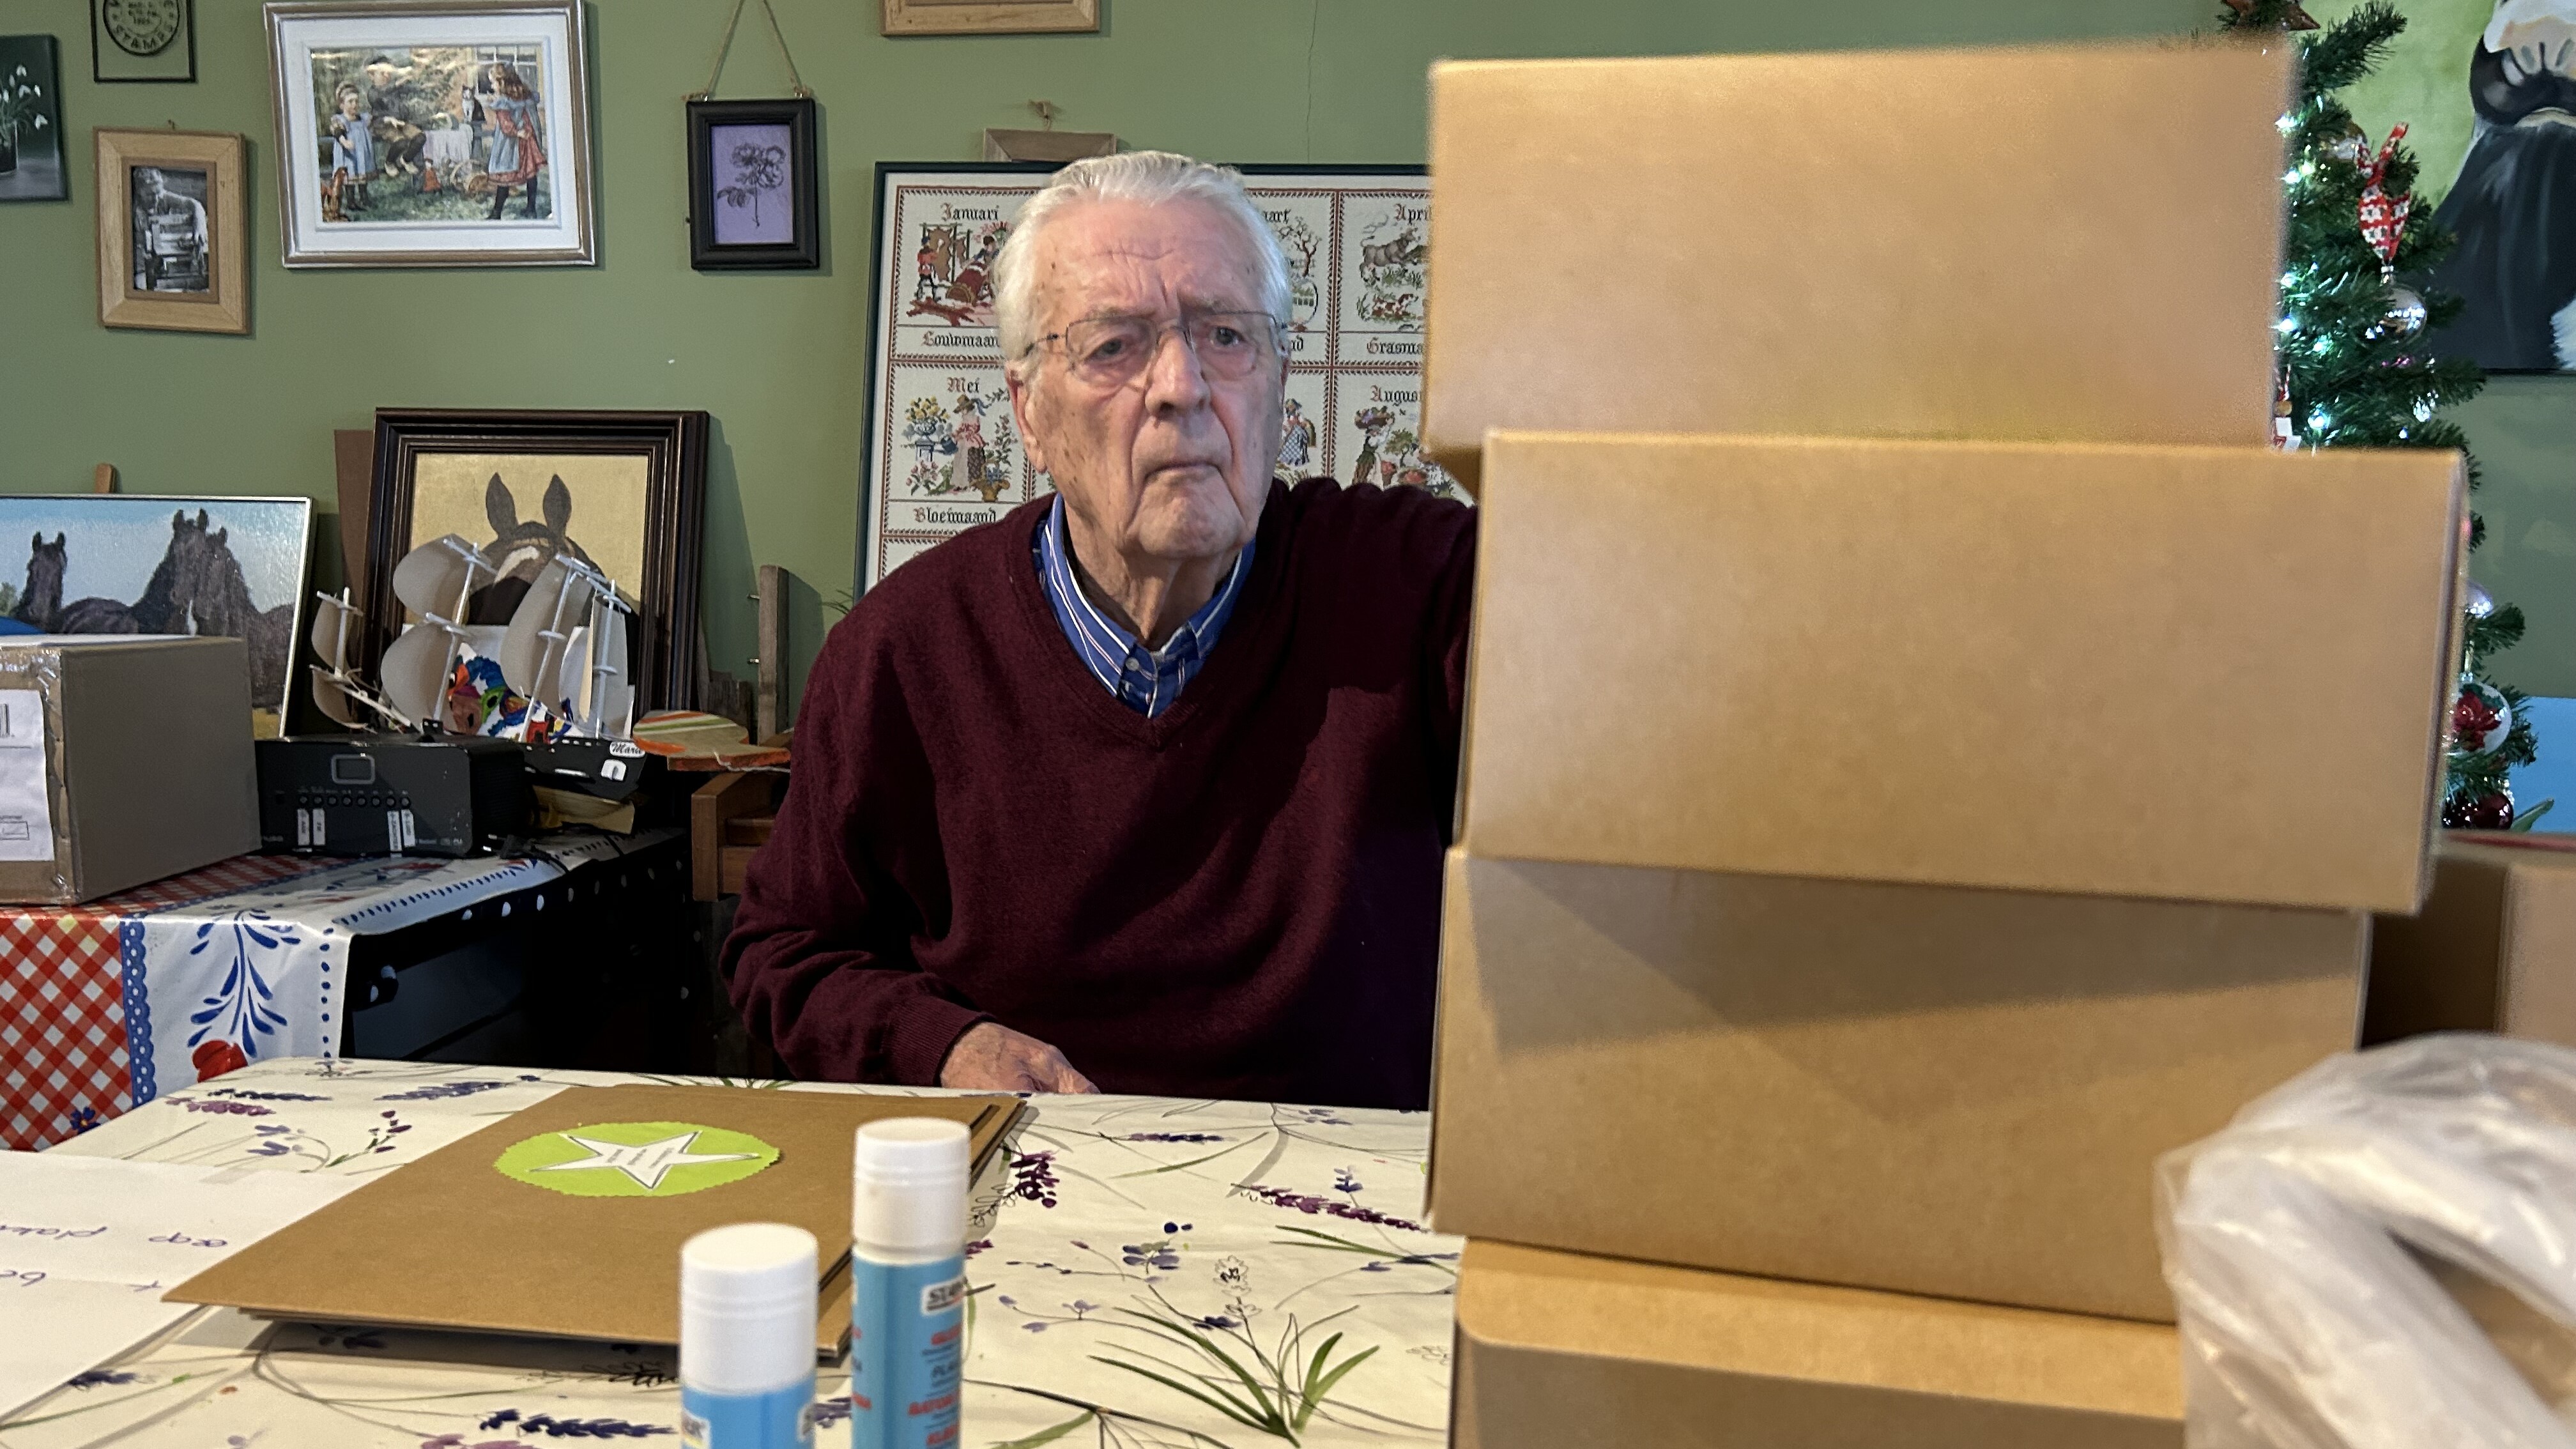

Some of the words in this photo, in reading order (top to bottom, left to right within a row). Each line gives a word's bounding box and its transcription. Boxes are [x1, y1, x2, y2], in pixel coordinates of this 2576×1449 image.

[940, 203, 999, 221] Januari
[921, 331, 1000, 348] Louwmaan
[947, 377, 979, 394] Mei
[1370, 385, 1418, 406] Augus
[914, 507, 997, 524] Bloeimaand
